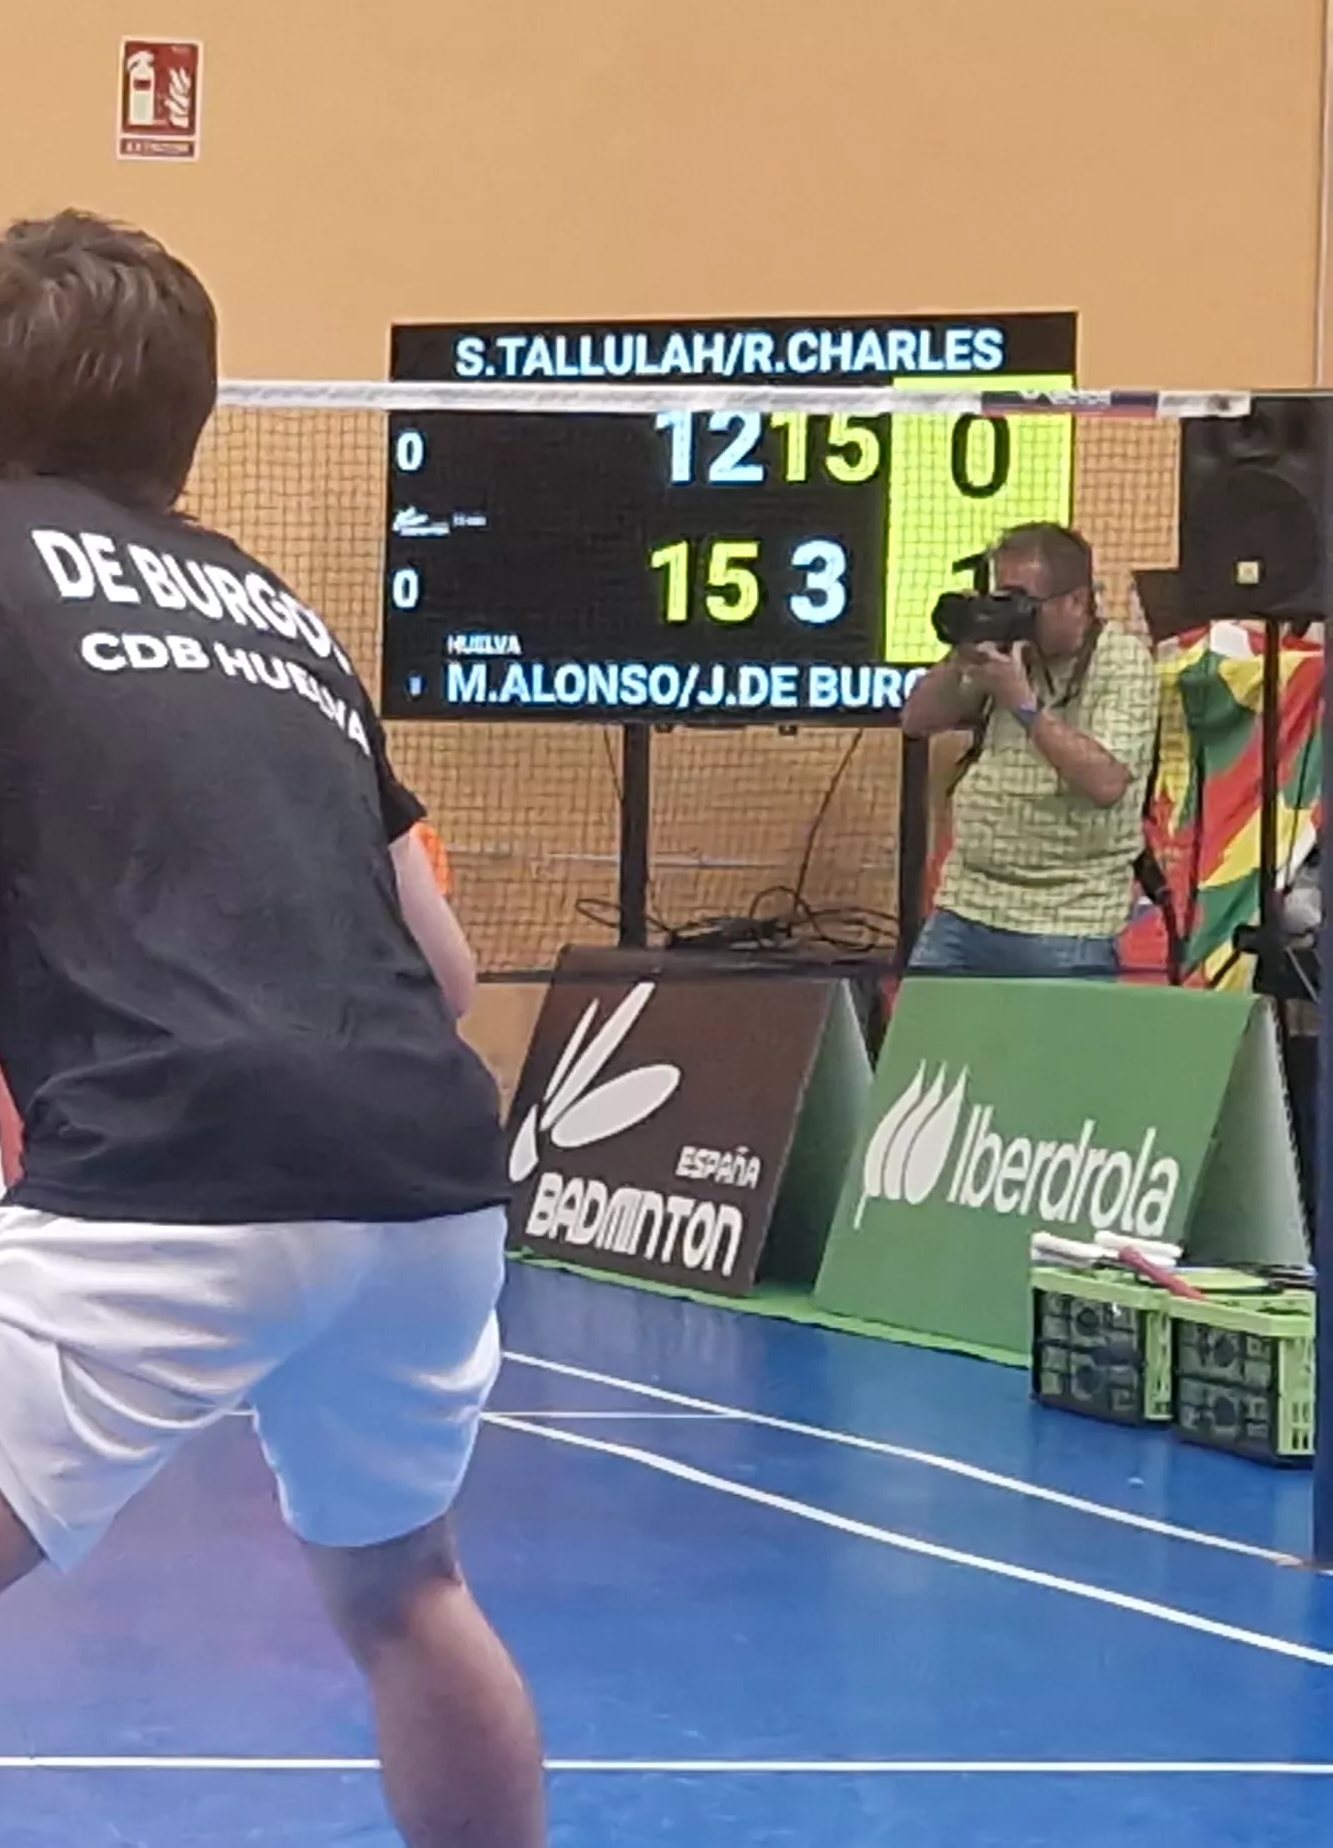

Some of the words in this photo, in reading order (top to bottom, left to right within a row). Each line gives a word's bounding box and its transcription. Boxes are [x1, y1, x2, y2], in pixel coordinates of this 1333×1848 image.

[455, 328, 1005, 378] S.TALLULAH/R.CHARLES
[396, 432, 424, 472] 0
[654, 411, 766, 483] 12
[770, 411, 881, 483] 15
[951, 412, 1011, 499] 0
[31, 529, 142, 605] DE
[392, 569, 419, 609] 0
[649, 538, 761, 624] 15
[788, 539, 849, 625] 3
[447, 634, 522, 656] HUELVA
[80, 632, 210, 672] CDB
[212, 641, 372, 758] HUELVA
[446, 661, 800, 710] M.ALONSO/J.DE
[674, 1145, 762, 1190] ESPAÑA
[946, 1103, 1181, 1237] Iberdrola
